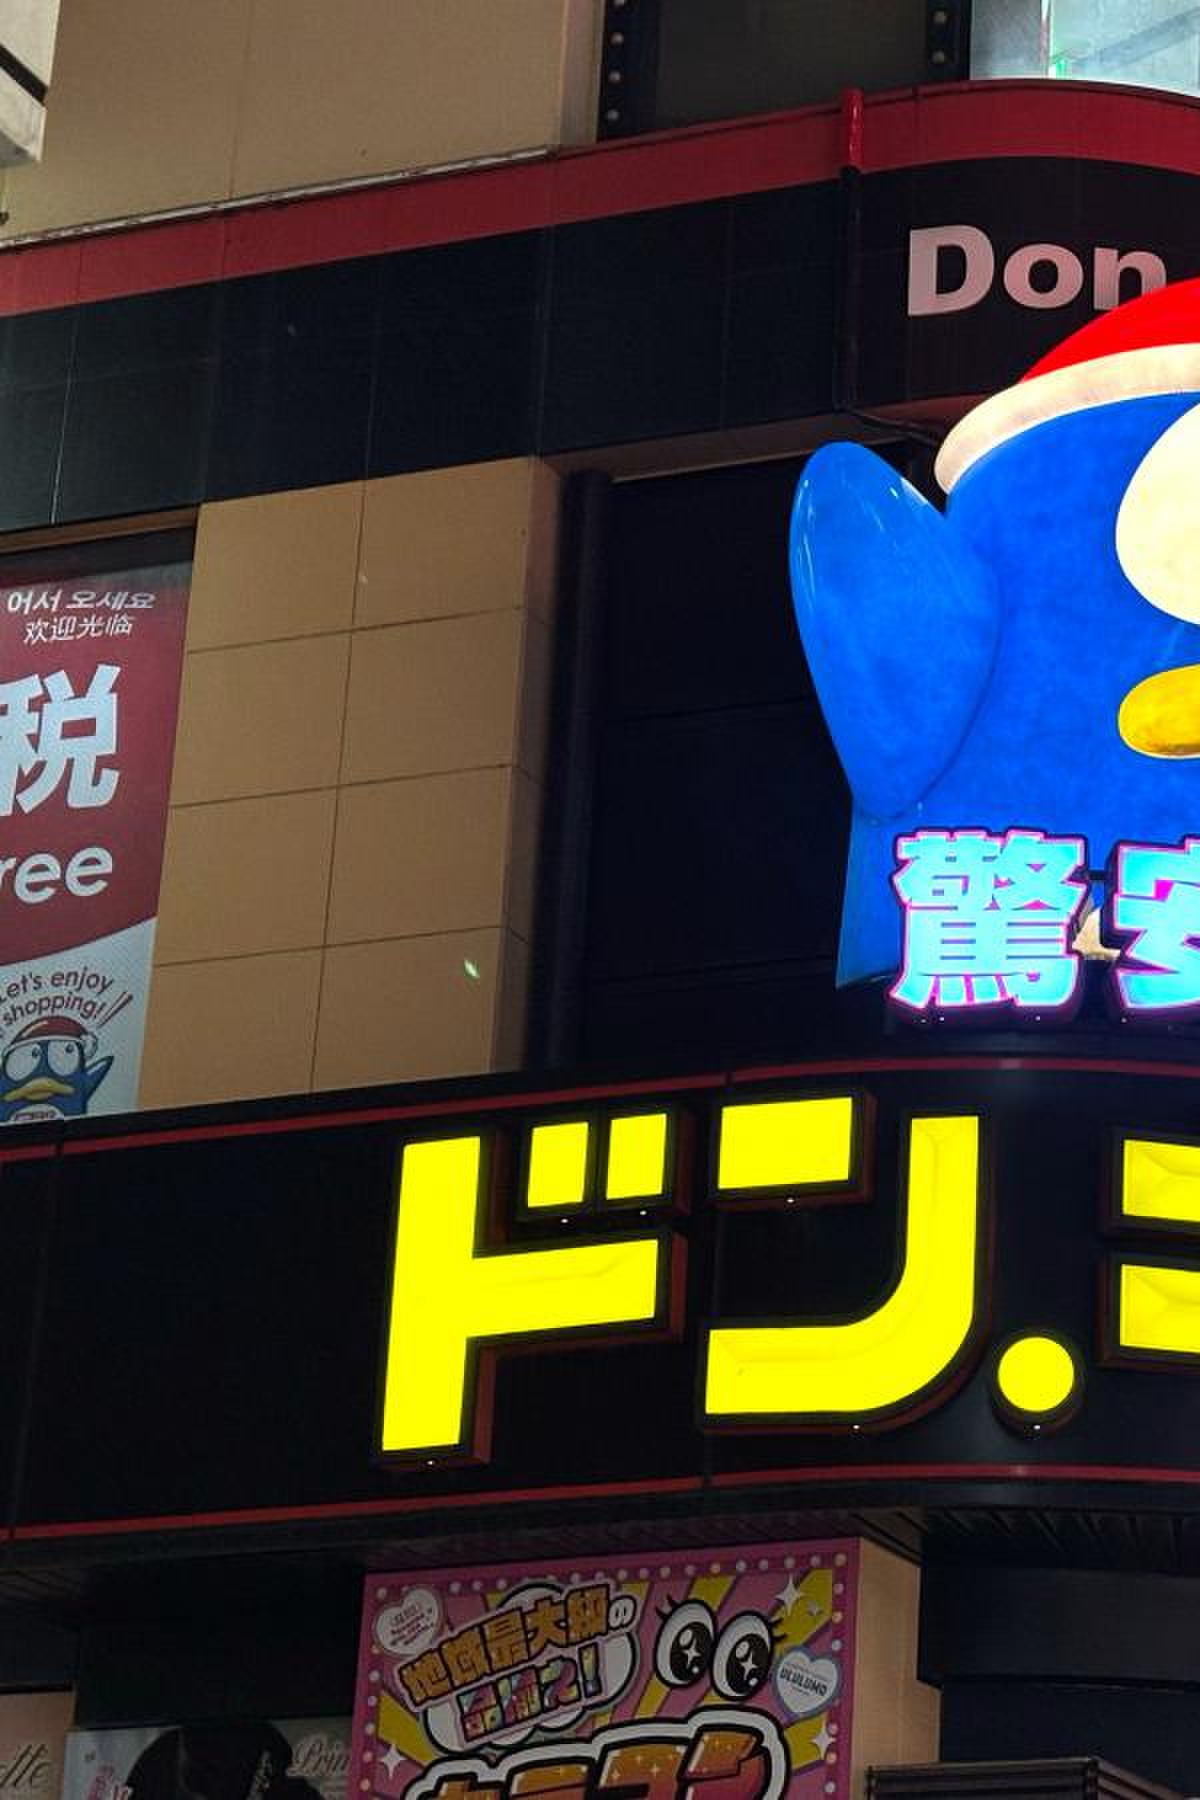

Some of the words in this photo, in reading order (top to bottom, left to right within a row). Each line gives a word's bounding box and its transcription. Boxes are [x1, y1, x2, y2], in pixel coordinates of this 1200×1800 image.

[907, 224, 1167, 317] Don
[8, 590, 62, 614] 어서
[66, 590, 156, 610] 오세요
[23, 613, 136, 645] 欢迎光临
[0, 663, 121, 818] 税
[0, 974, 42, 1003] et's
[51, 966, 114, 994] enjoy
